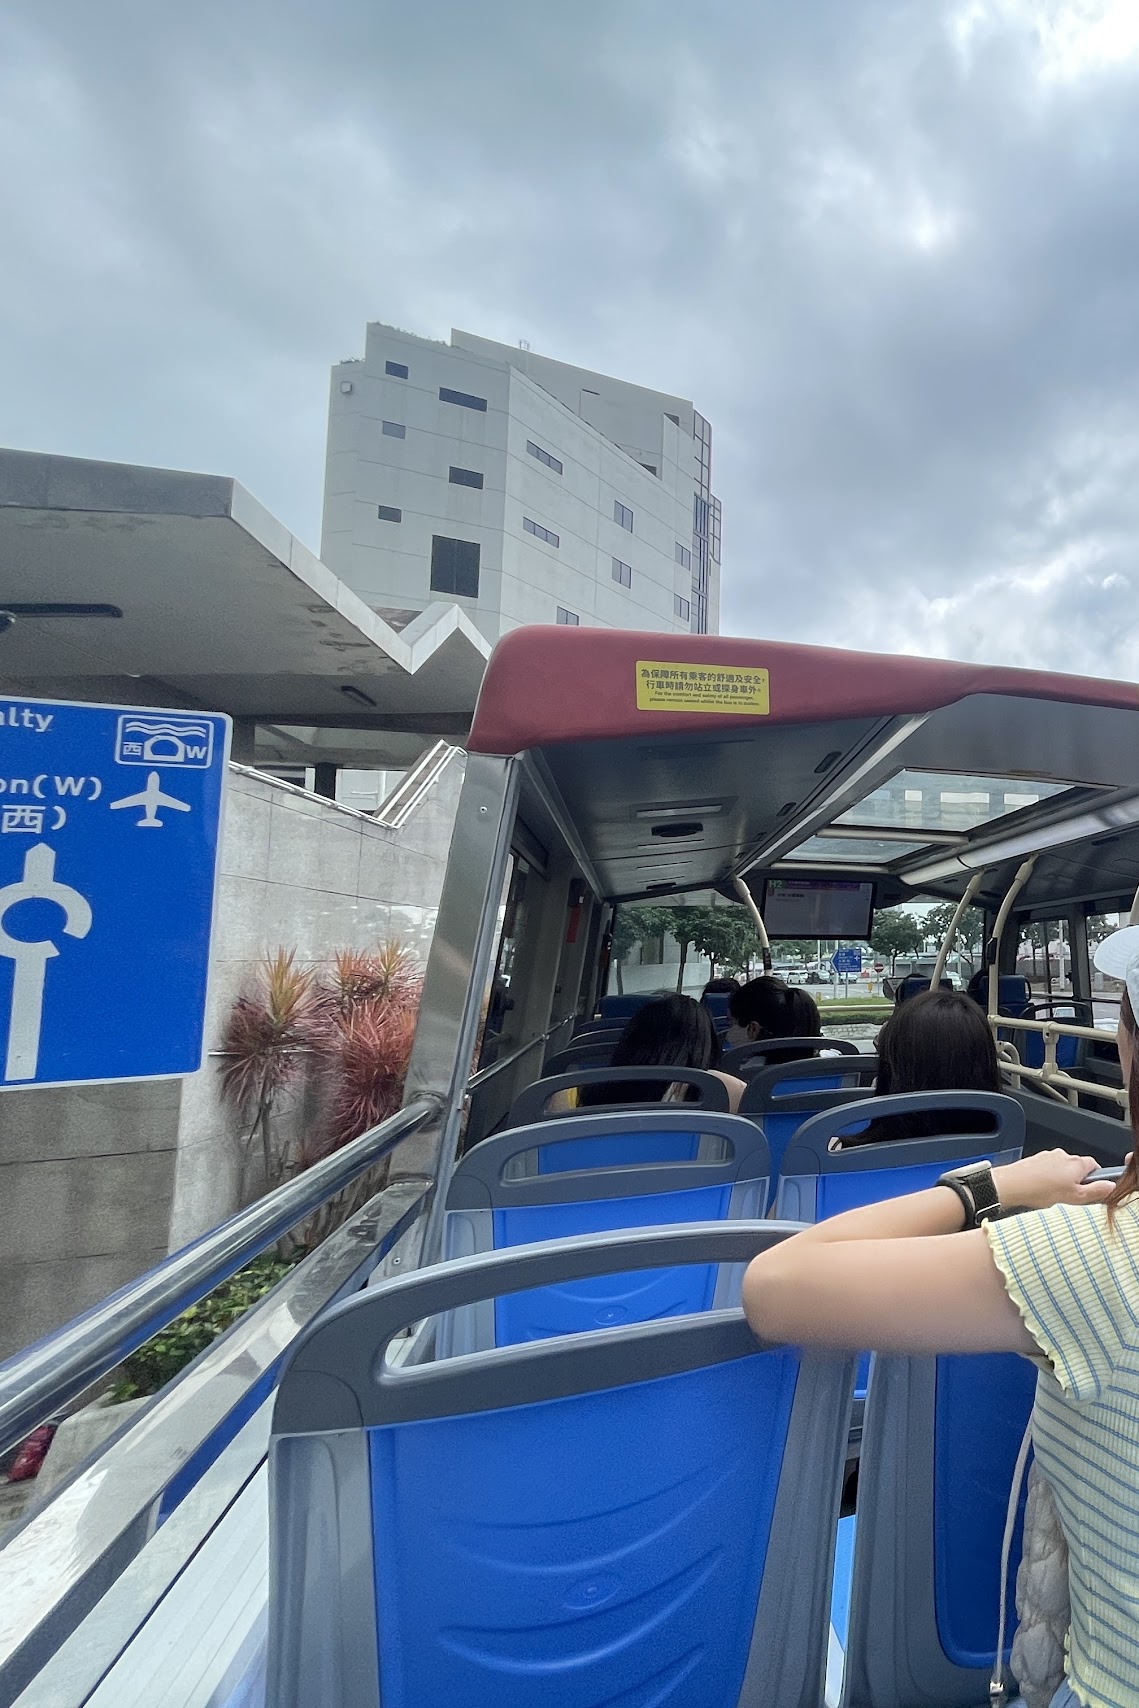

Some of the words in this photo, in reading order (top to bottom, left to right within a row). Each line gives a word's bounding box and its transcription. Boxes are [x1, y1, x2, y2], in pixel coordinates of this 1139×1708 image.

[122, 742, 143, 756] 西
[185, 746, 207, 759] W
[769, 880, 783, 888] H2
